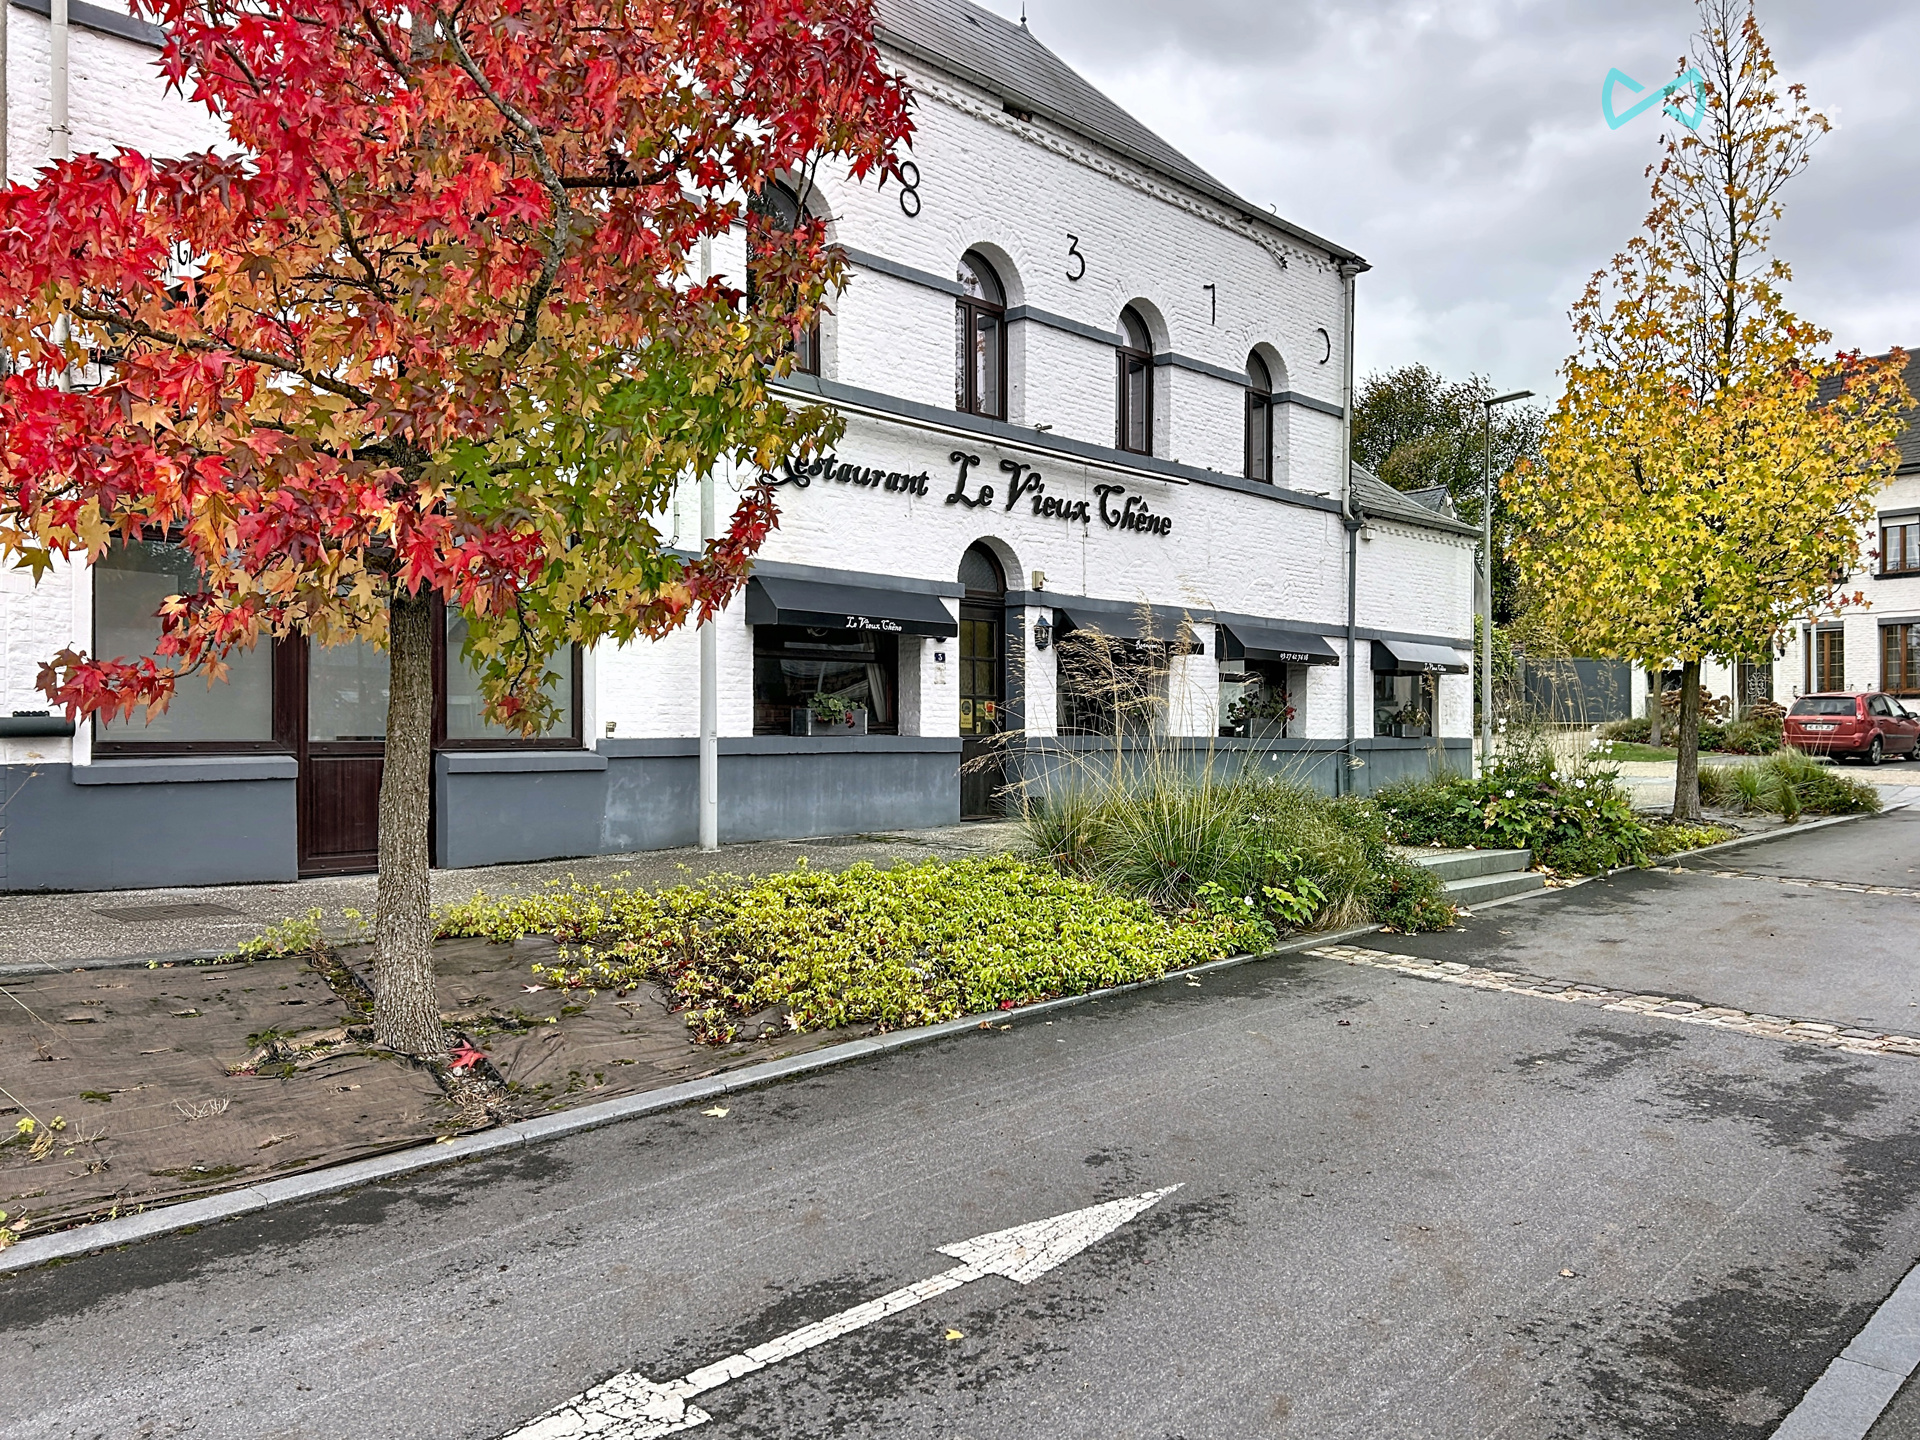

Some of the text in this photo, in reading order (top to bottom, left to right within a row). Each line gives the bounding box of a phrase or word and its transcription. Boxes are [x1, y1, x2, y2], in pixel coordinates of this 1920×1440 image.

[900, 161, 920, 217] 8
[1066, 234, 1086, 281] 3
[945, 451, 995, 508] Le
[999, 459, 1091, 523] Vieux
[846, 616, 857, 628] Le
